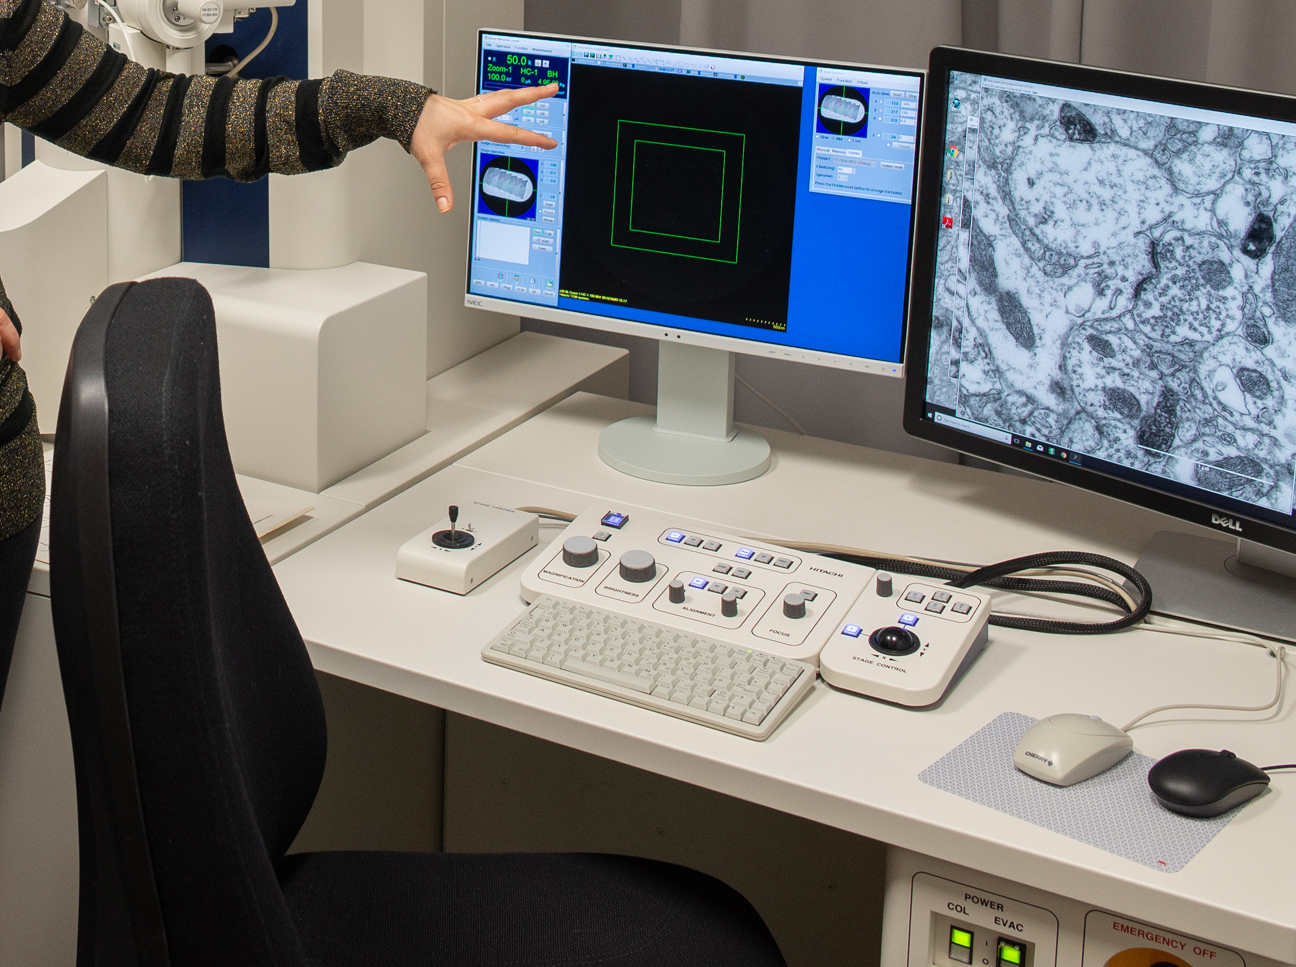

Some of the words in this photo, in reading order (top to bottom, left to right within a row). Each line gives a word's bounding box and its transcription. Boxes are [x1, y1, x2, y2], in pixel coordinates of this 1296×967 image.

[507, 54, 527, 65] 50.0
[487, 64, 512, 73] Zoom-1
[521, 68, 538, 76] HC-1
[488, 73, 506, 82] 100.0
[1212, 514, 1242, 532] DELL
[543, 569, 585, 583] MAGNIFICATION
[810, 566, 844, 578] HITACHI
[604, 586, 639, 597] BRIGHTNESS
[682, 606, 716, 618] ALIGNMENT
[769, 628, 791, 638] FOCUS
[852, 656, 874, 665] STAGE
[876, 662, 907, 674] CONTROL
[1025, 751, 1048, 763] CHERRY
[964, 893, 1004, 912] POWER
[947, 902, 969, 916] COL
[994, 916, 1024, 932] EVAC
[1112, 921, 1186, 950] EMERGENCY
[1193, 946, 1217, 960] OFF
